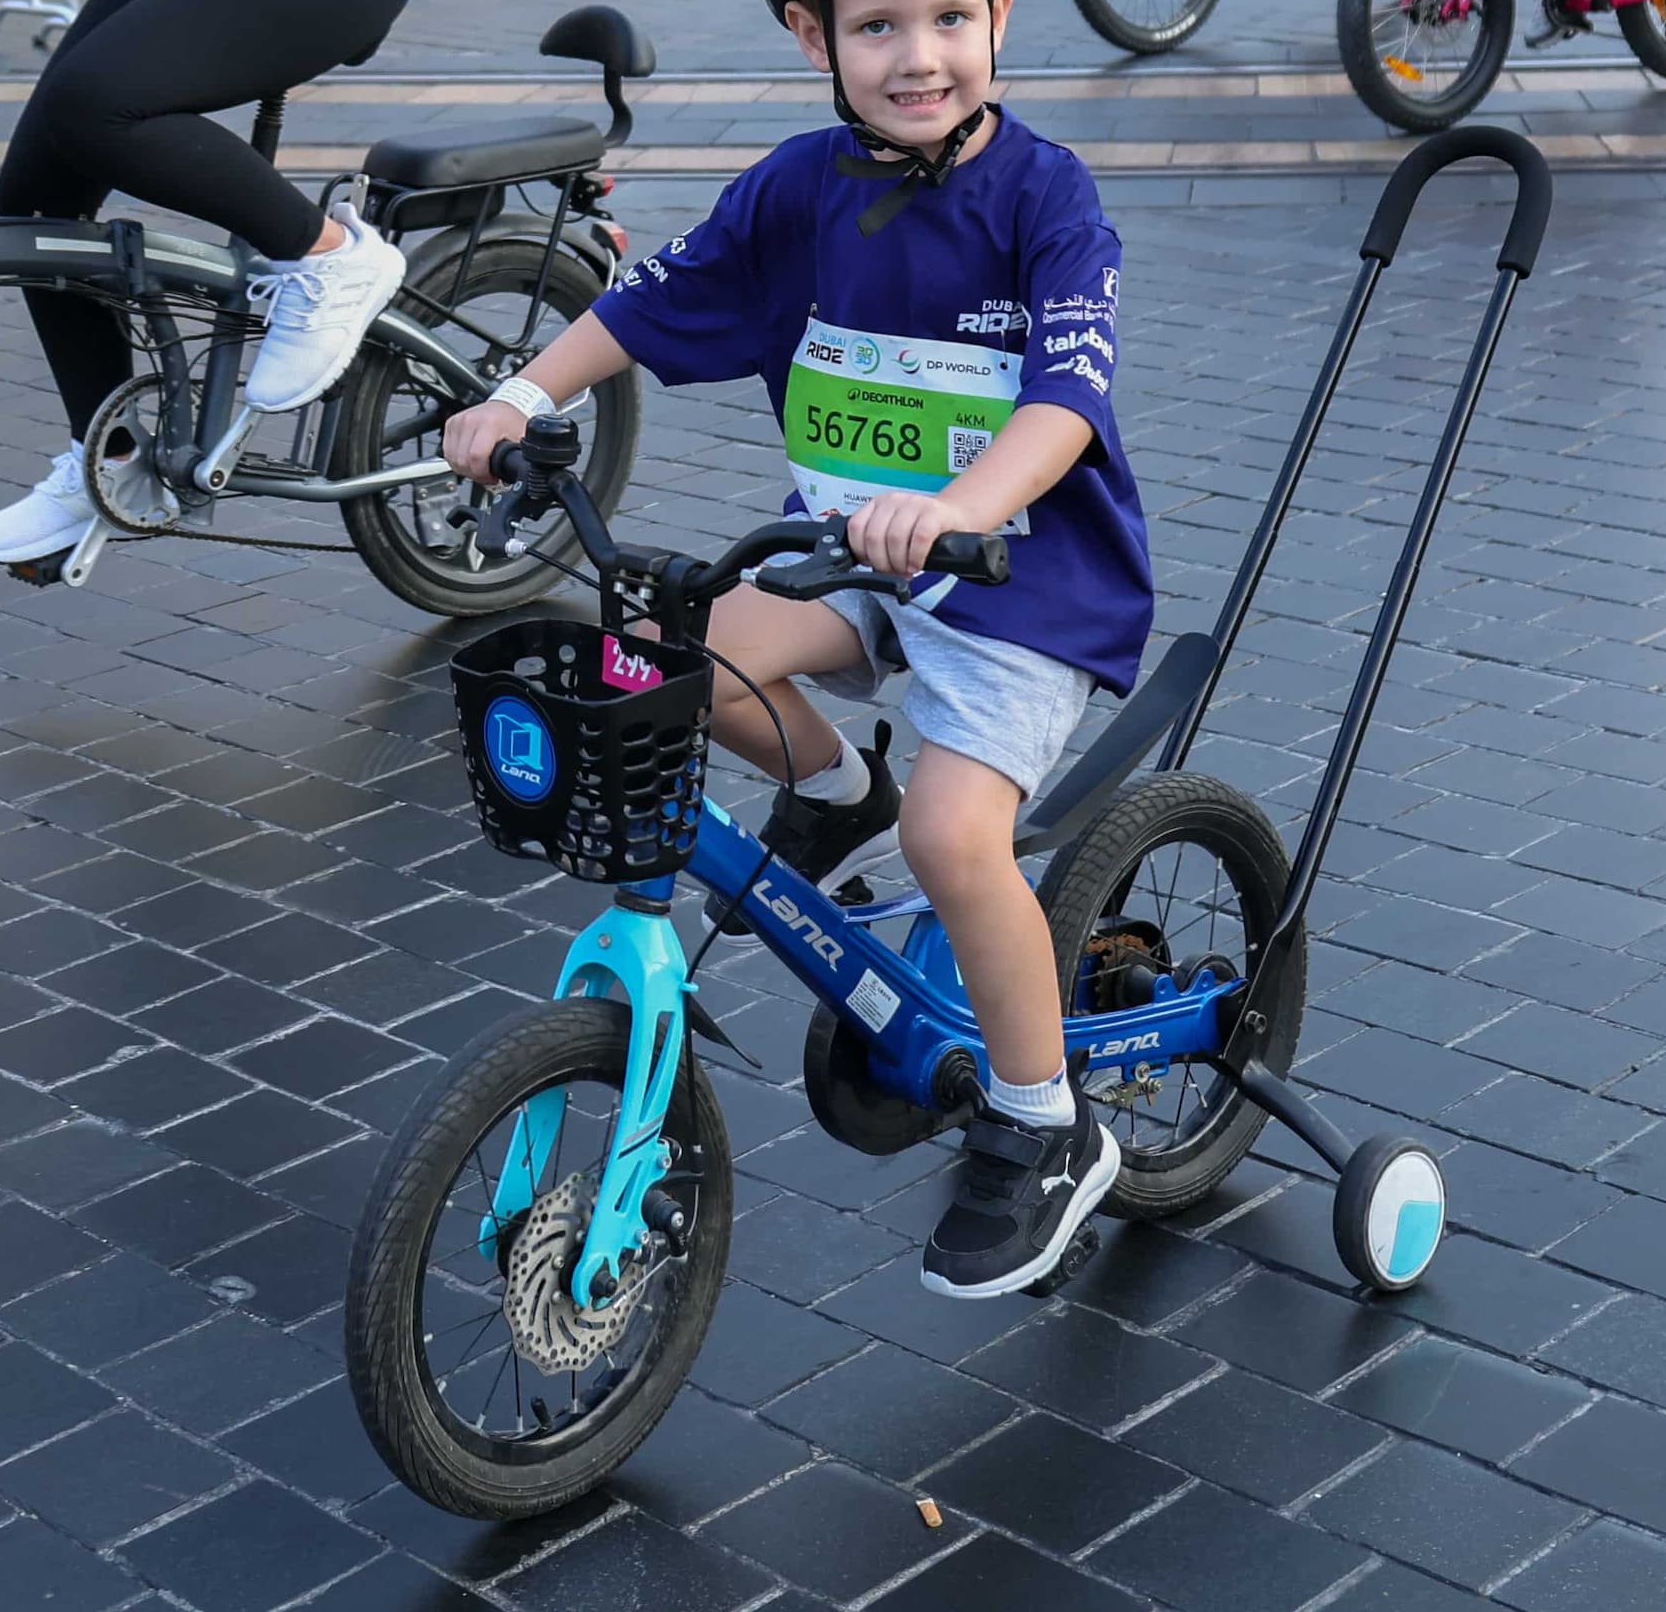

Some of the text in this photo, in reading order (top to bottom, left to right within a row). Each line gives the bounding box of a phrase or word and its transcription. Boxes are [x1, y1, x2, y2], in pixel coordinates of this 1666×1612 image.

[956, 312, 1027, 333] RIDE
[819, 332, 846, 348] DUBAI
[806, 341, 845, 365] RIDE
[926, 360, 991, 376] DP WORLD
[862, 391, 924, 410] DECATHLON
[955, 412, 986, 428] 4KM
[806, 405, 923, 462] 56768
